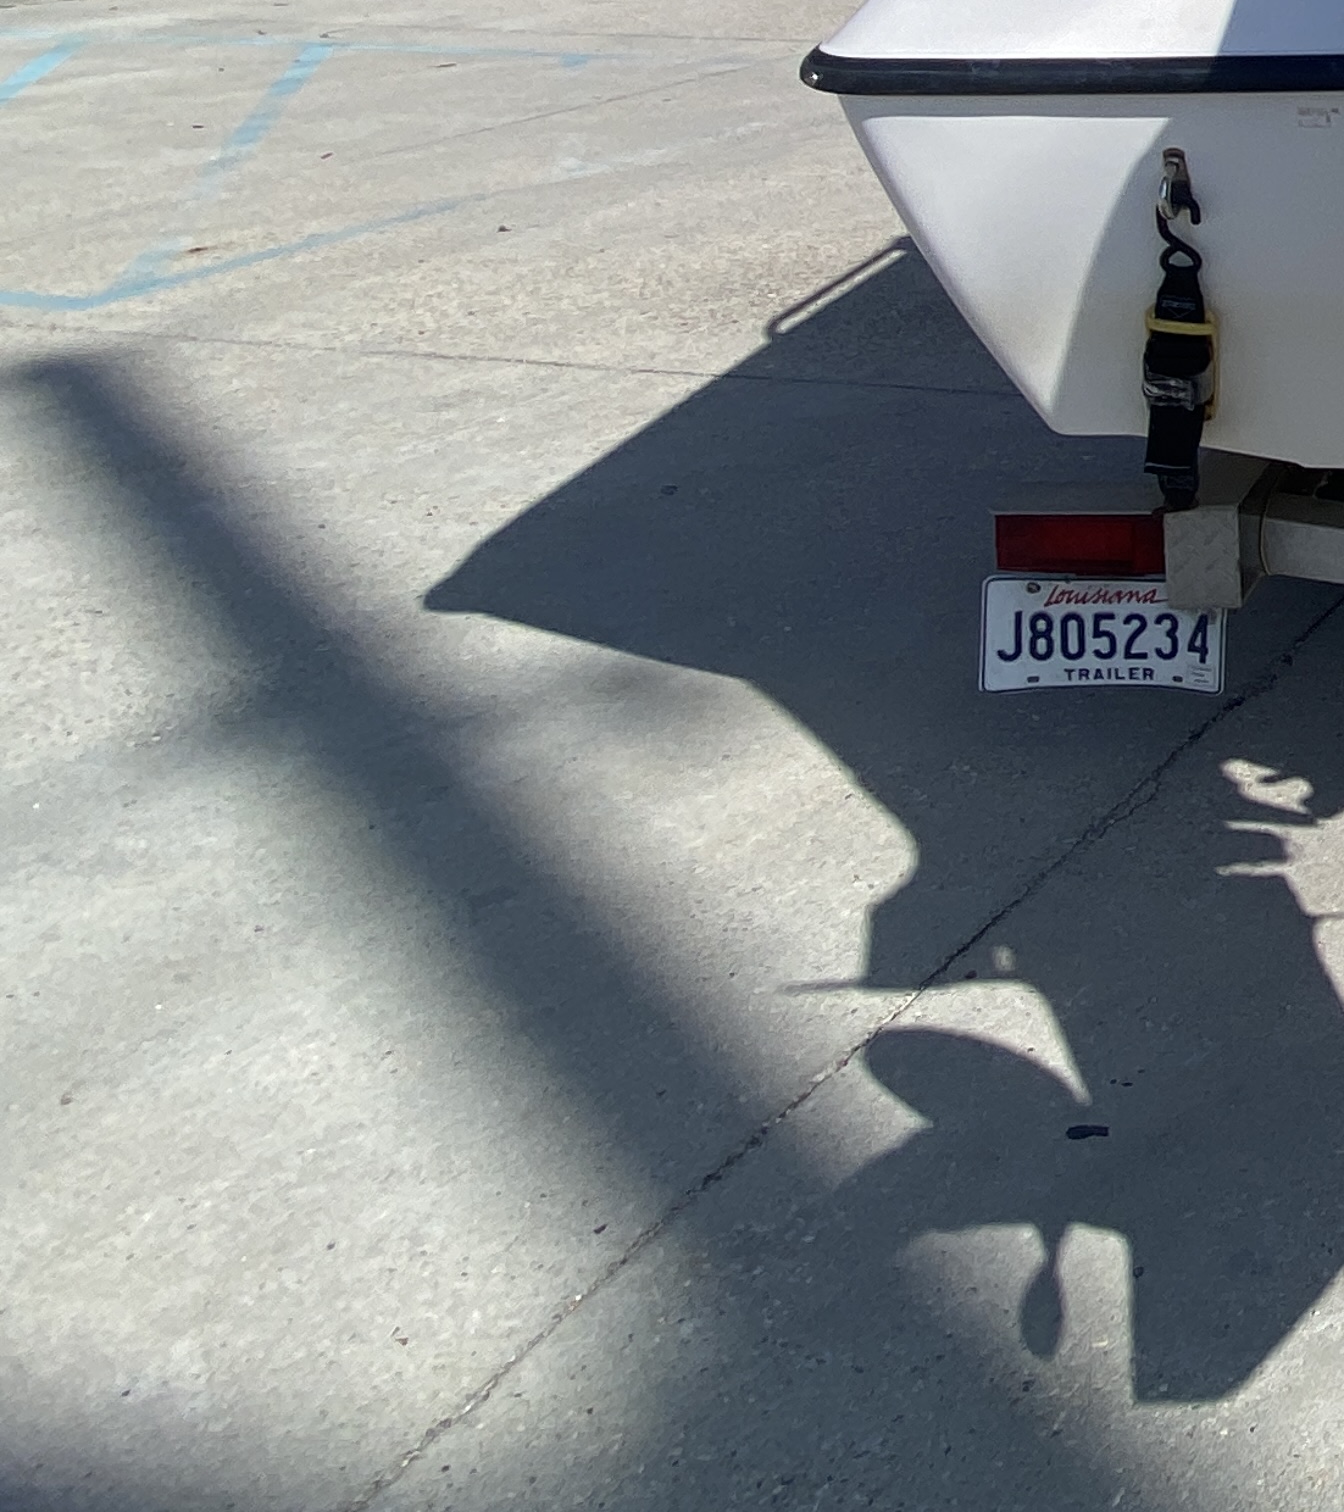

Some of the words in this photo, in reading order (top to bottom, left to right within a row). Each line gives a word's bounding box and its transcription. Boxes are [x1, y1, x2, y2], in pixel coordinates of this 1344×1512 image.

[1043, 584, 1169, 607] Louisiana
[997, 610, 1209, 664] J805234
[1063, 667, 1155, 682] TRAILER
